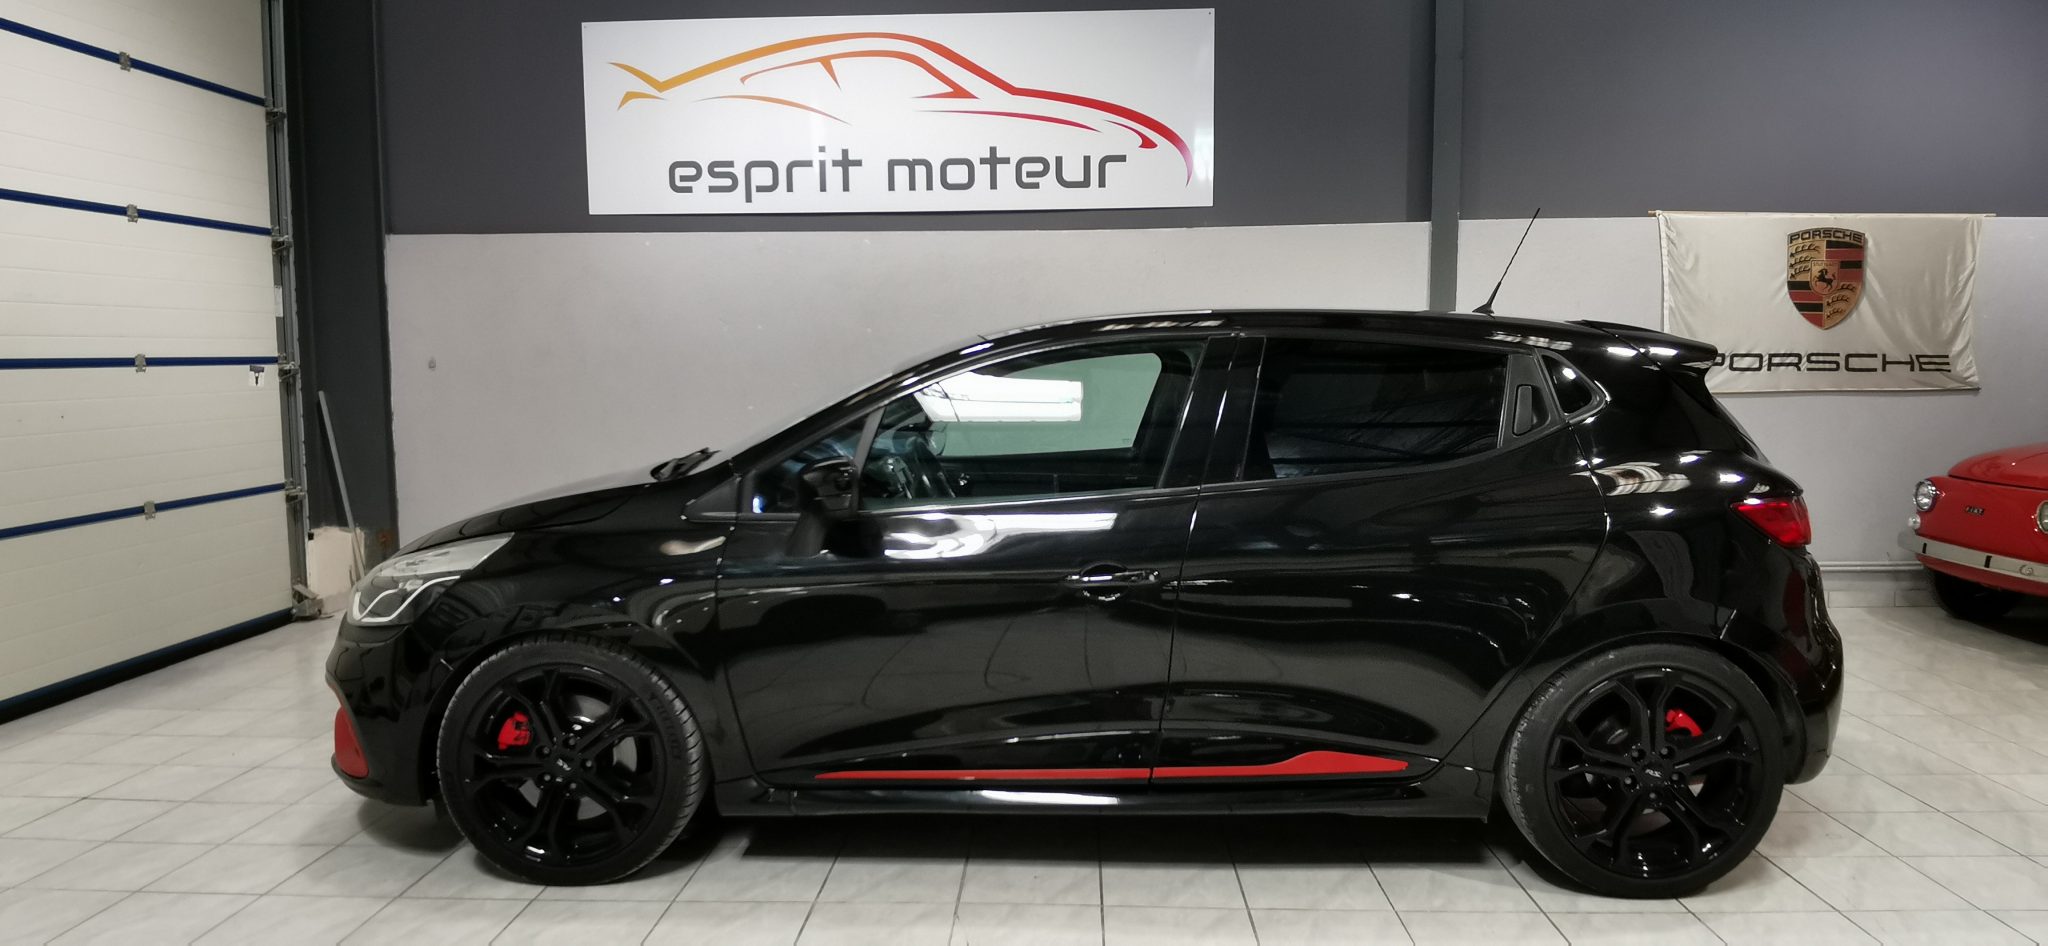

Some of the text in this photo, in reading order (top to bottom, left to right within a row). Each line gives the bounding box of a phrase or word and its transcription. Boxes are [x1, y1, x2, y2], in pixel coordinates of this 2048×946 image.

[669, 146, 1127, 203] esprit moteur
[1789, 229, 1863, 244] PORSCHE
